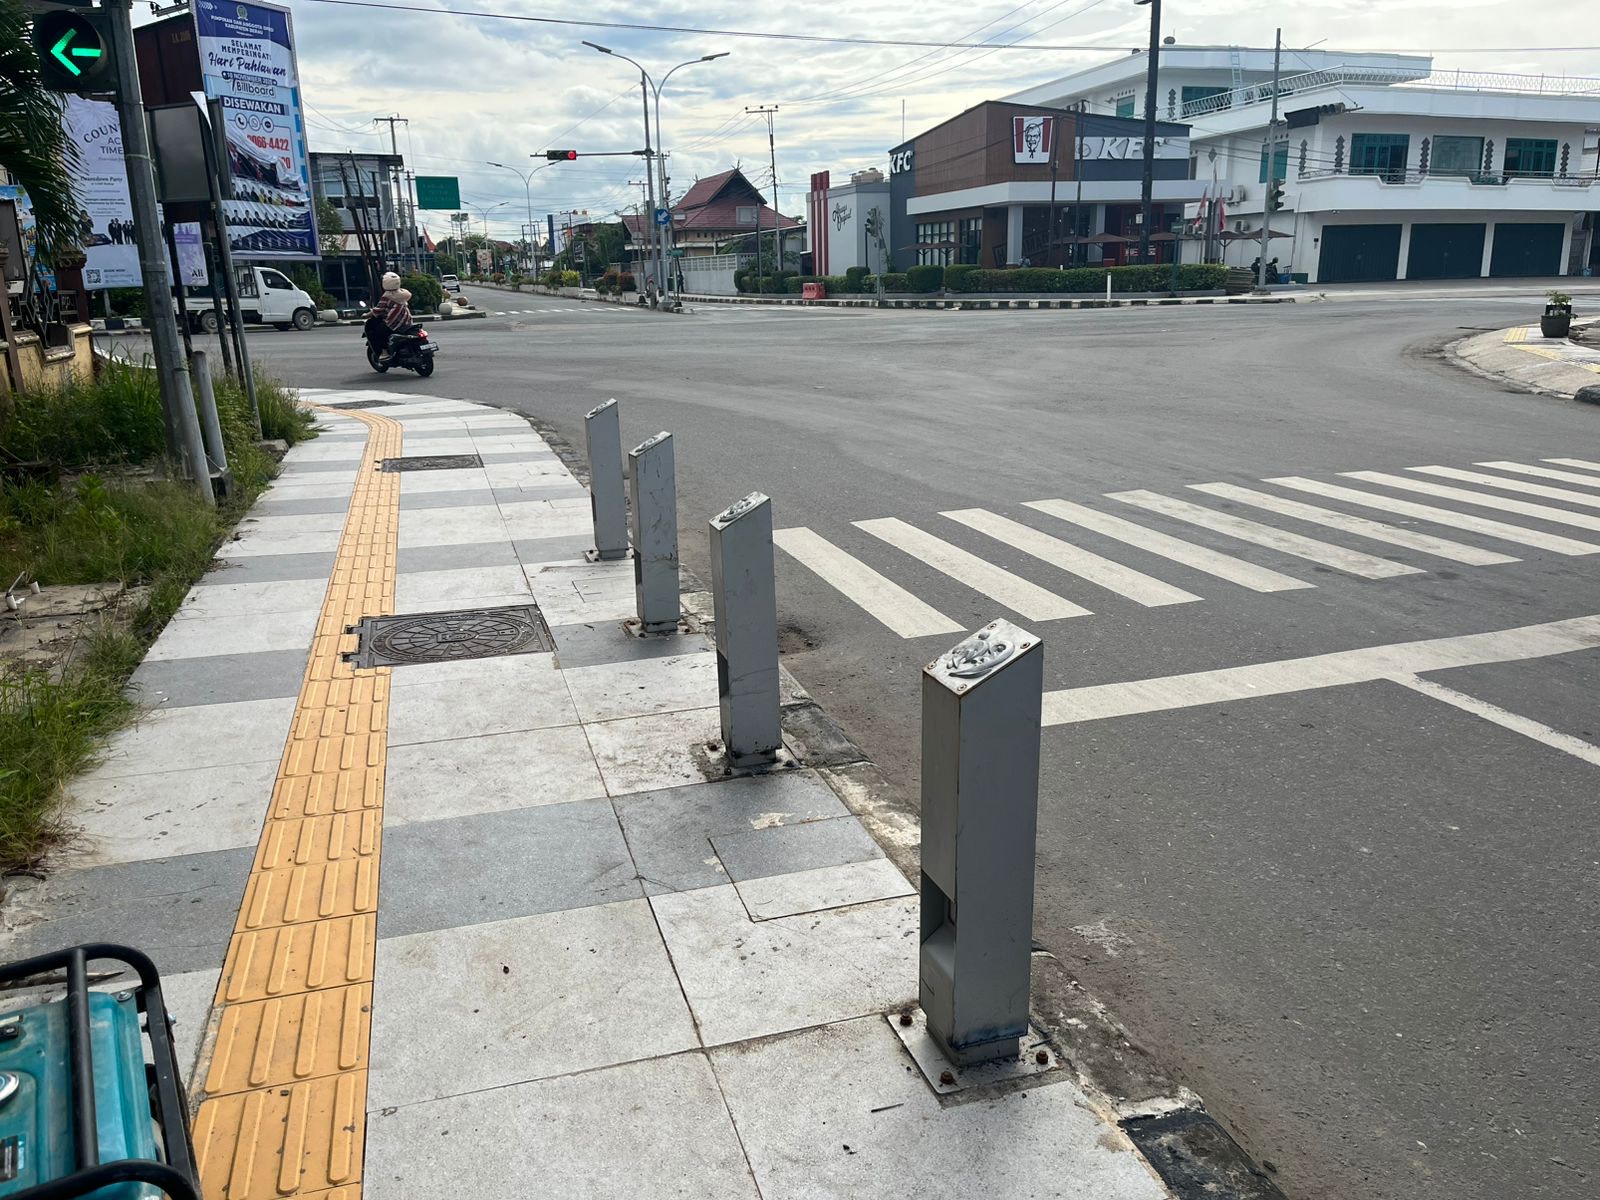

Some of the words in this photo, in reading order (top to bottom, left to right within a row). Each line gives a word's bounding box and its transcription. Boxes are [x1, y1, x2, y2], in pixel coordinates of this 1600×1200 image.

[221, 45, 272, 61] MEMPERINGATI
[231, 39, 262, 52] SELAMAT
[208, 51, 234, 68] Hari
[236, 56, 287, 77] Pahlawan
[236, 81, 275, 97] Billboard
[223, 97, 281, 114] DISEWAKAN
[83, 123, 120, 144] COUN
[247, 134, 290, 151] 066-4422
[889, 150, 914, 174] KFC
